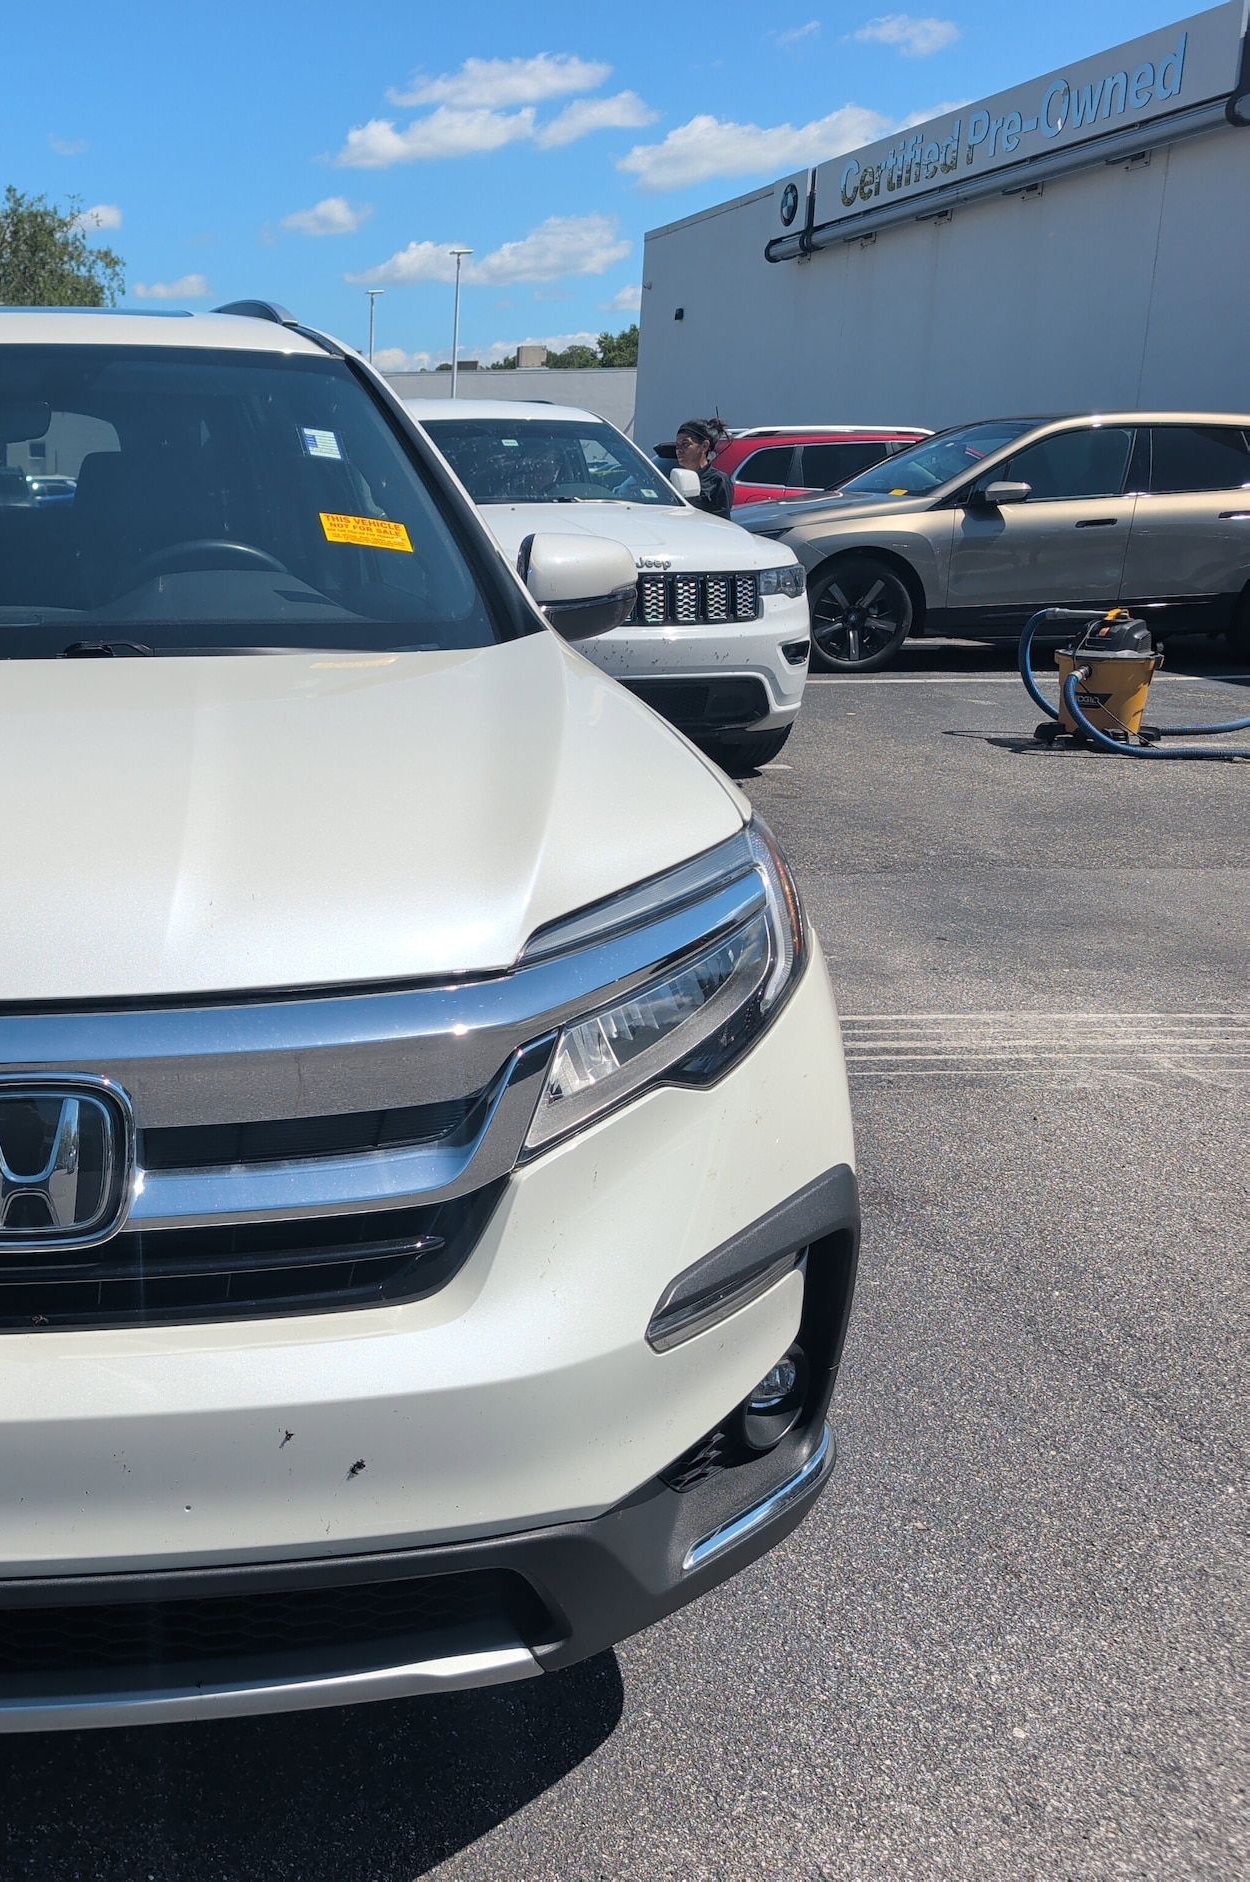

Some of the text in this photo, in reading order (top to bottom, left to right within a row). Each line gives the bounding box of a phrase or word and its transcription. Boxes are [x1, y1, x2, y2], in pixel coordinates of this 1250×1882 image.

[840, 31, 1188, 207] Certified Pre-Owned
[324, 514, 402, 531] THIS VEHICLE
[352, 525, 373, 533] FOR
[376, 528, 402, 537] SALE
[635, 556, 672, 571] Jeep
